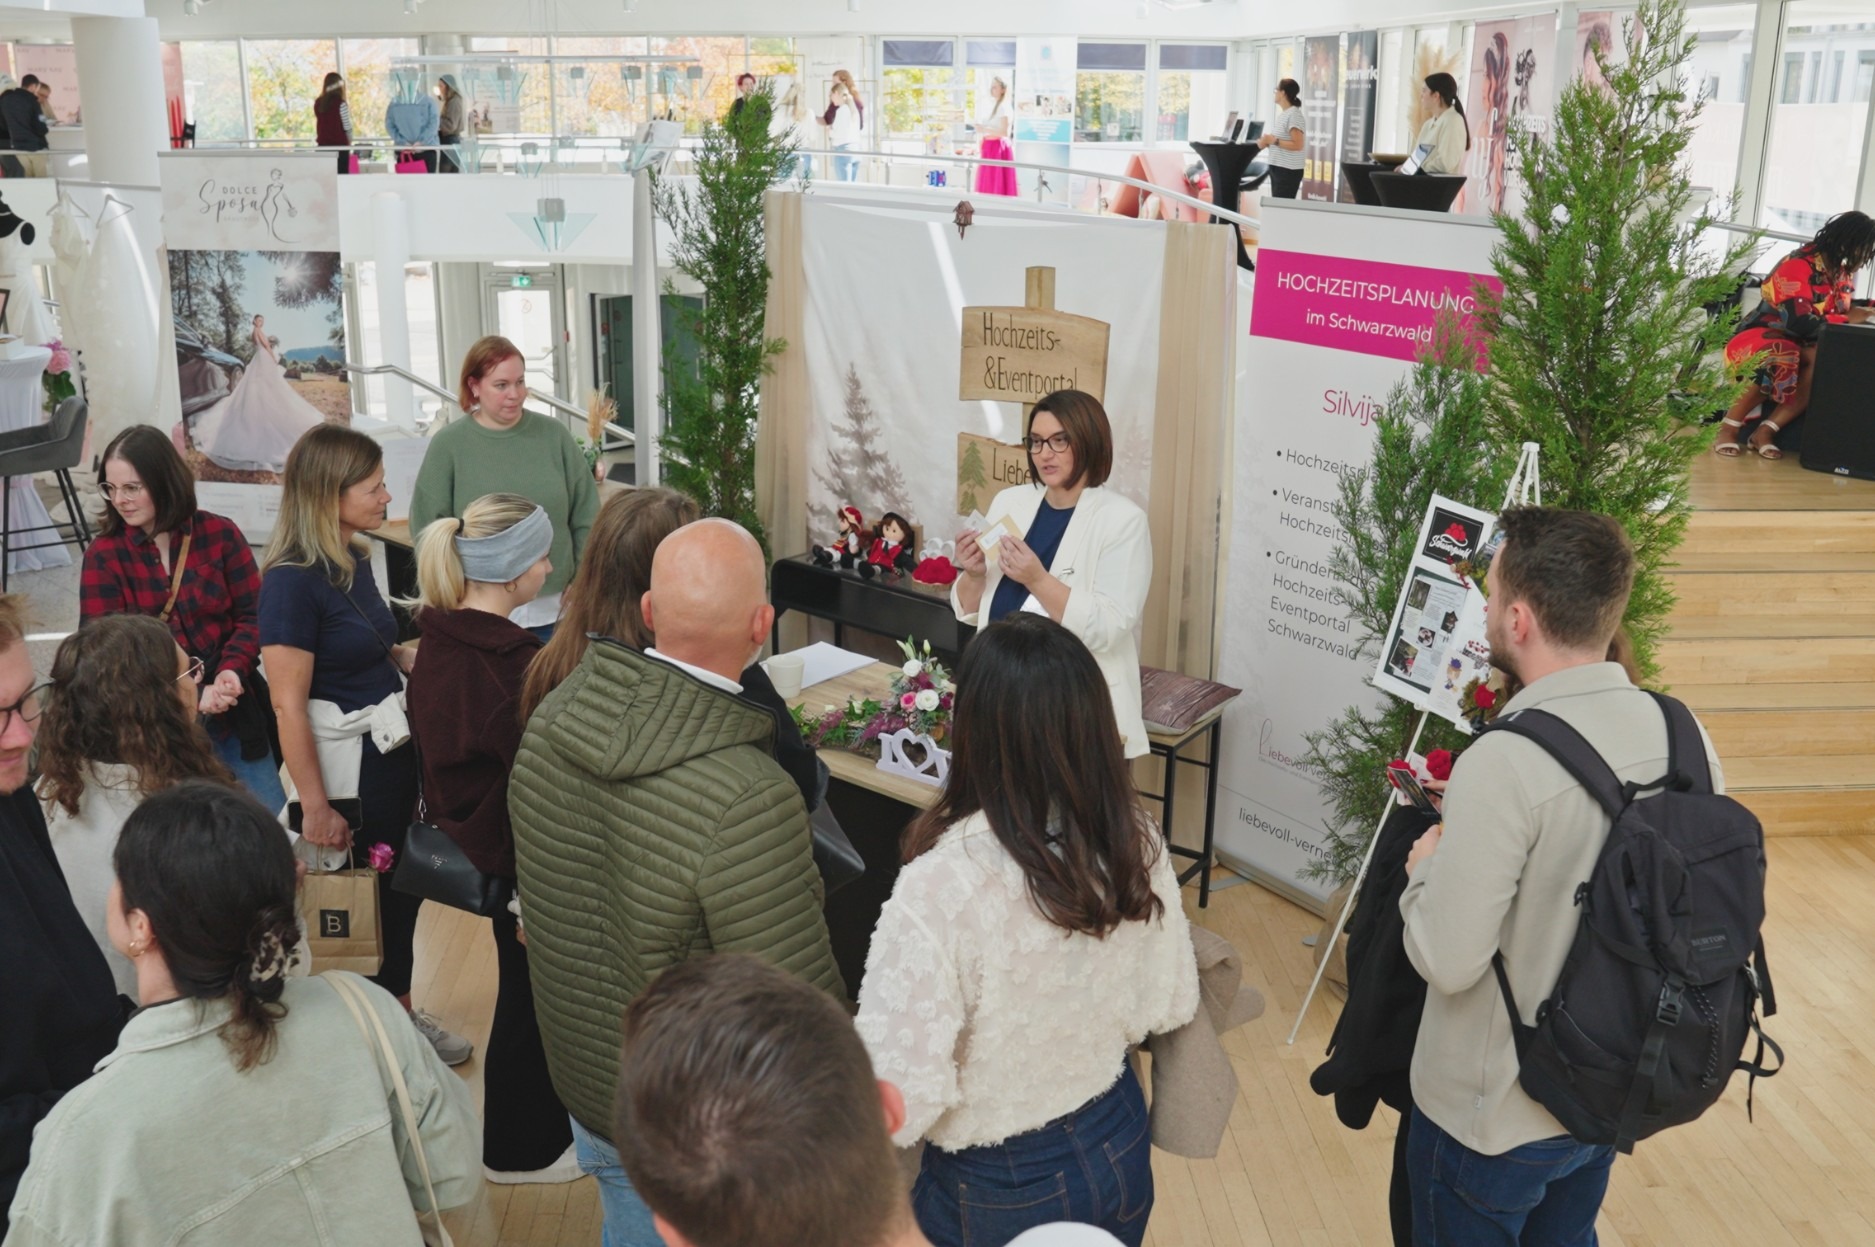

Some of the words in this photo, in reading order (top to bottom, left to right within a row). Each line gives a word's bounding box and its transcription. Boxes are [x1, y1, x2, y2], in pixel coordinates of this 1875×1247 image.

[199, 179, 262, 223] Sposa
[222, 186, 257, 195] DOLCE
[1277, 271, 1475, 315] HOCHZEITSPLANUNG
[982, 311, 1062, 352] Hochzeits-
[1306, 308, 1325, 327] im
[1328, 312, 1433, 343] Schwarzwald
[1322, 388, 1384, 427] Silvija
[992, 447, 1033, 487] Liebe
[1286, 448, 1381, 483] Hochzeitspla
[1271, 595, 1351, 634] Eventportal
[1267, 618, 1358, 661] Schwarzwald
[1238, 807, 1334, 863] liebevoll-verne
